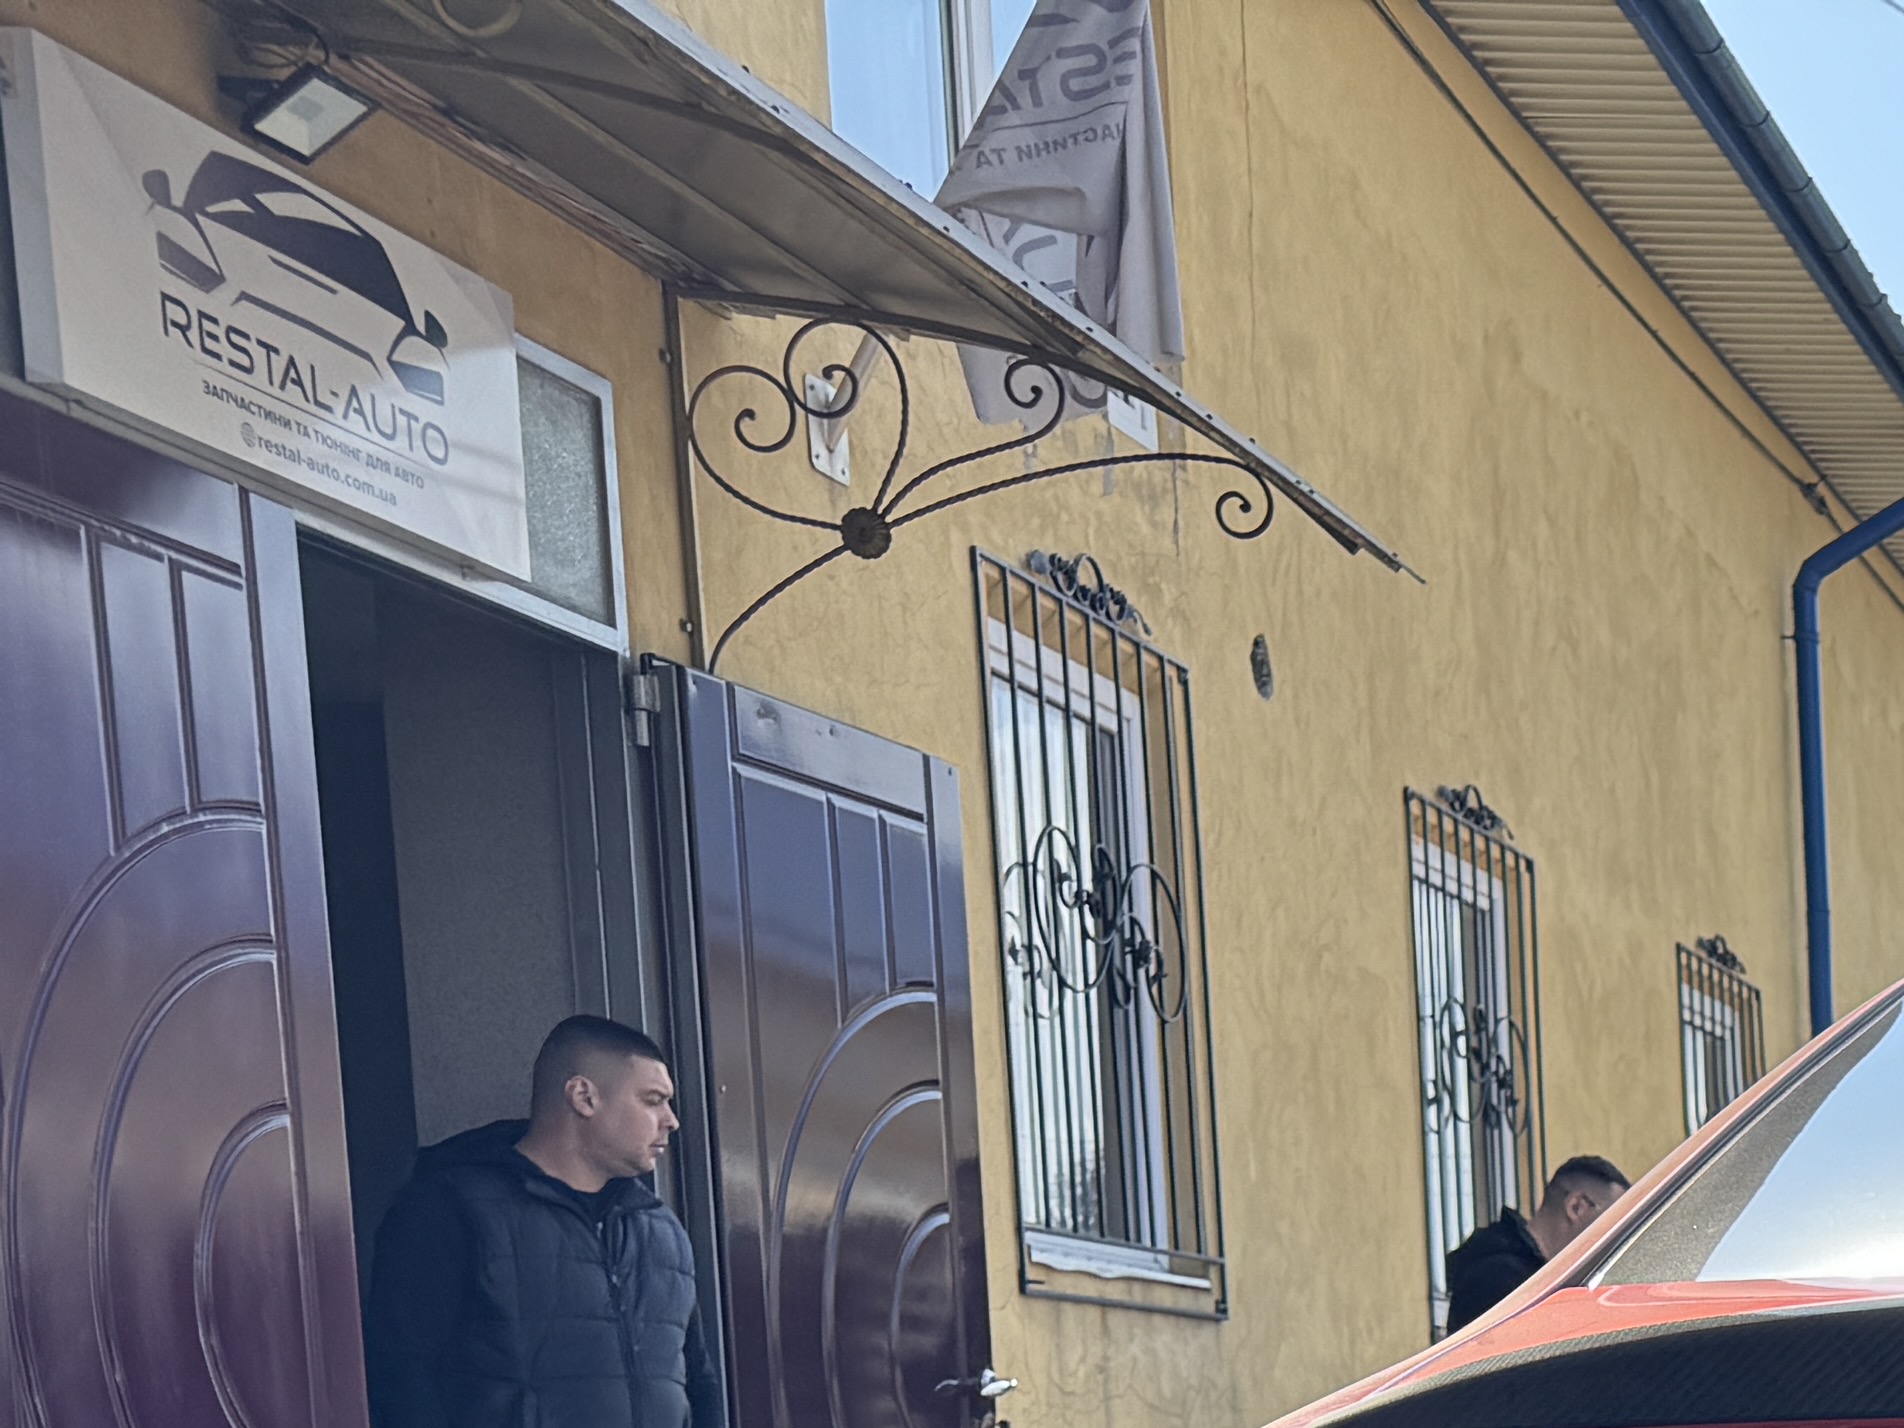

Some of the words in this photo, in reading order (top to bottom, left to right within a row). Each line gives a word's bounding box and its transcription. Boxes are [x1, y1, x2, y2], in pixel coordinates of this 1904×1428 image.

[160, 290, 449, 466] RESTAL-AUTO
[202, 379, 292, 431] ЗАПЧАСТИНИ
[293, 420, 311, 440] ТА
[394, 465, 424, 490] АВТО
[257, 434, 397, 506] restal-auto.com.ua
